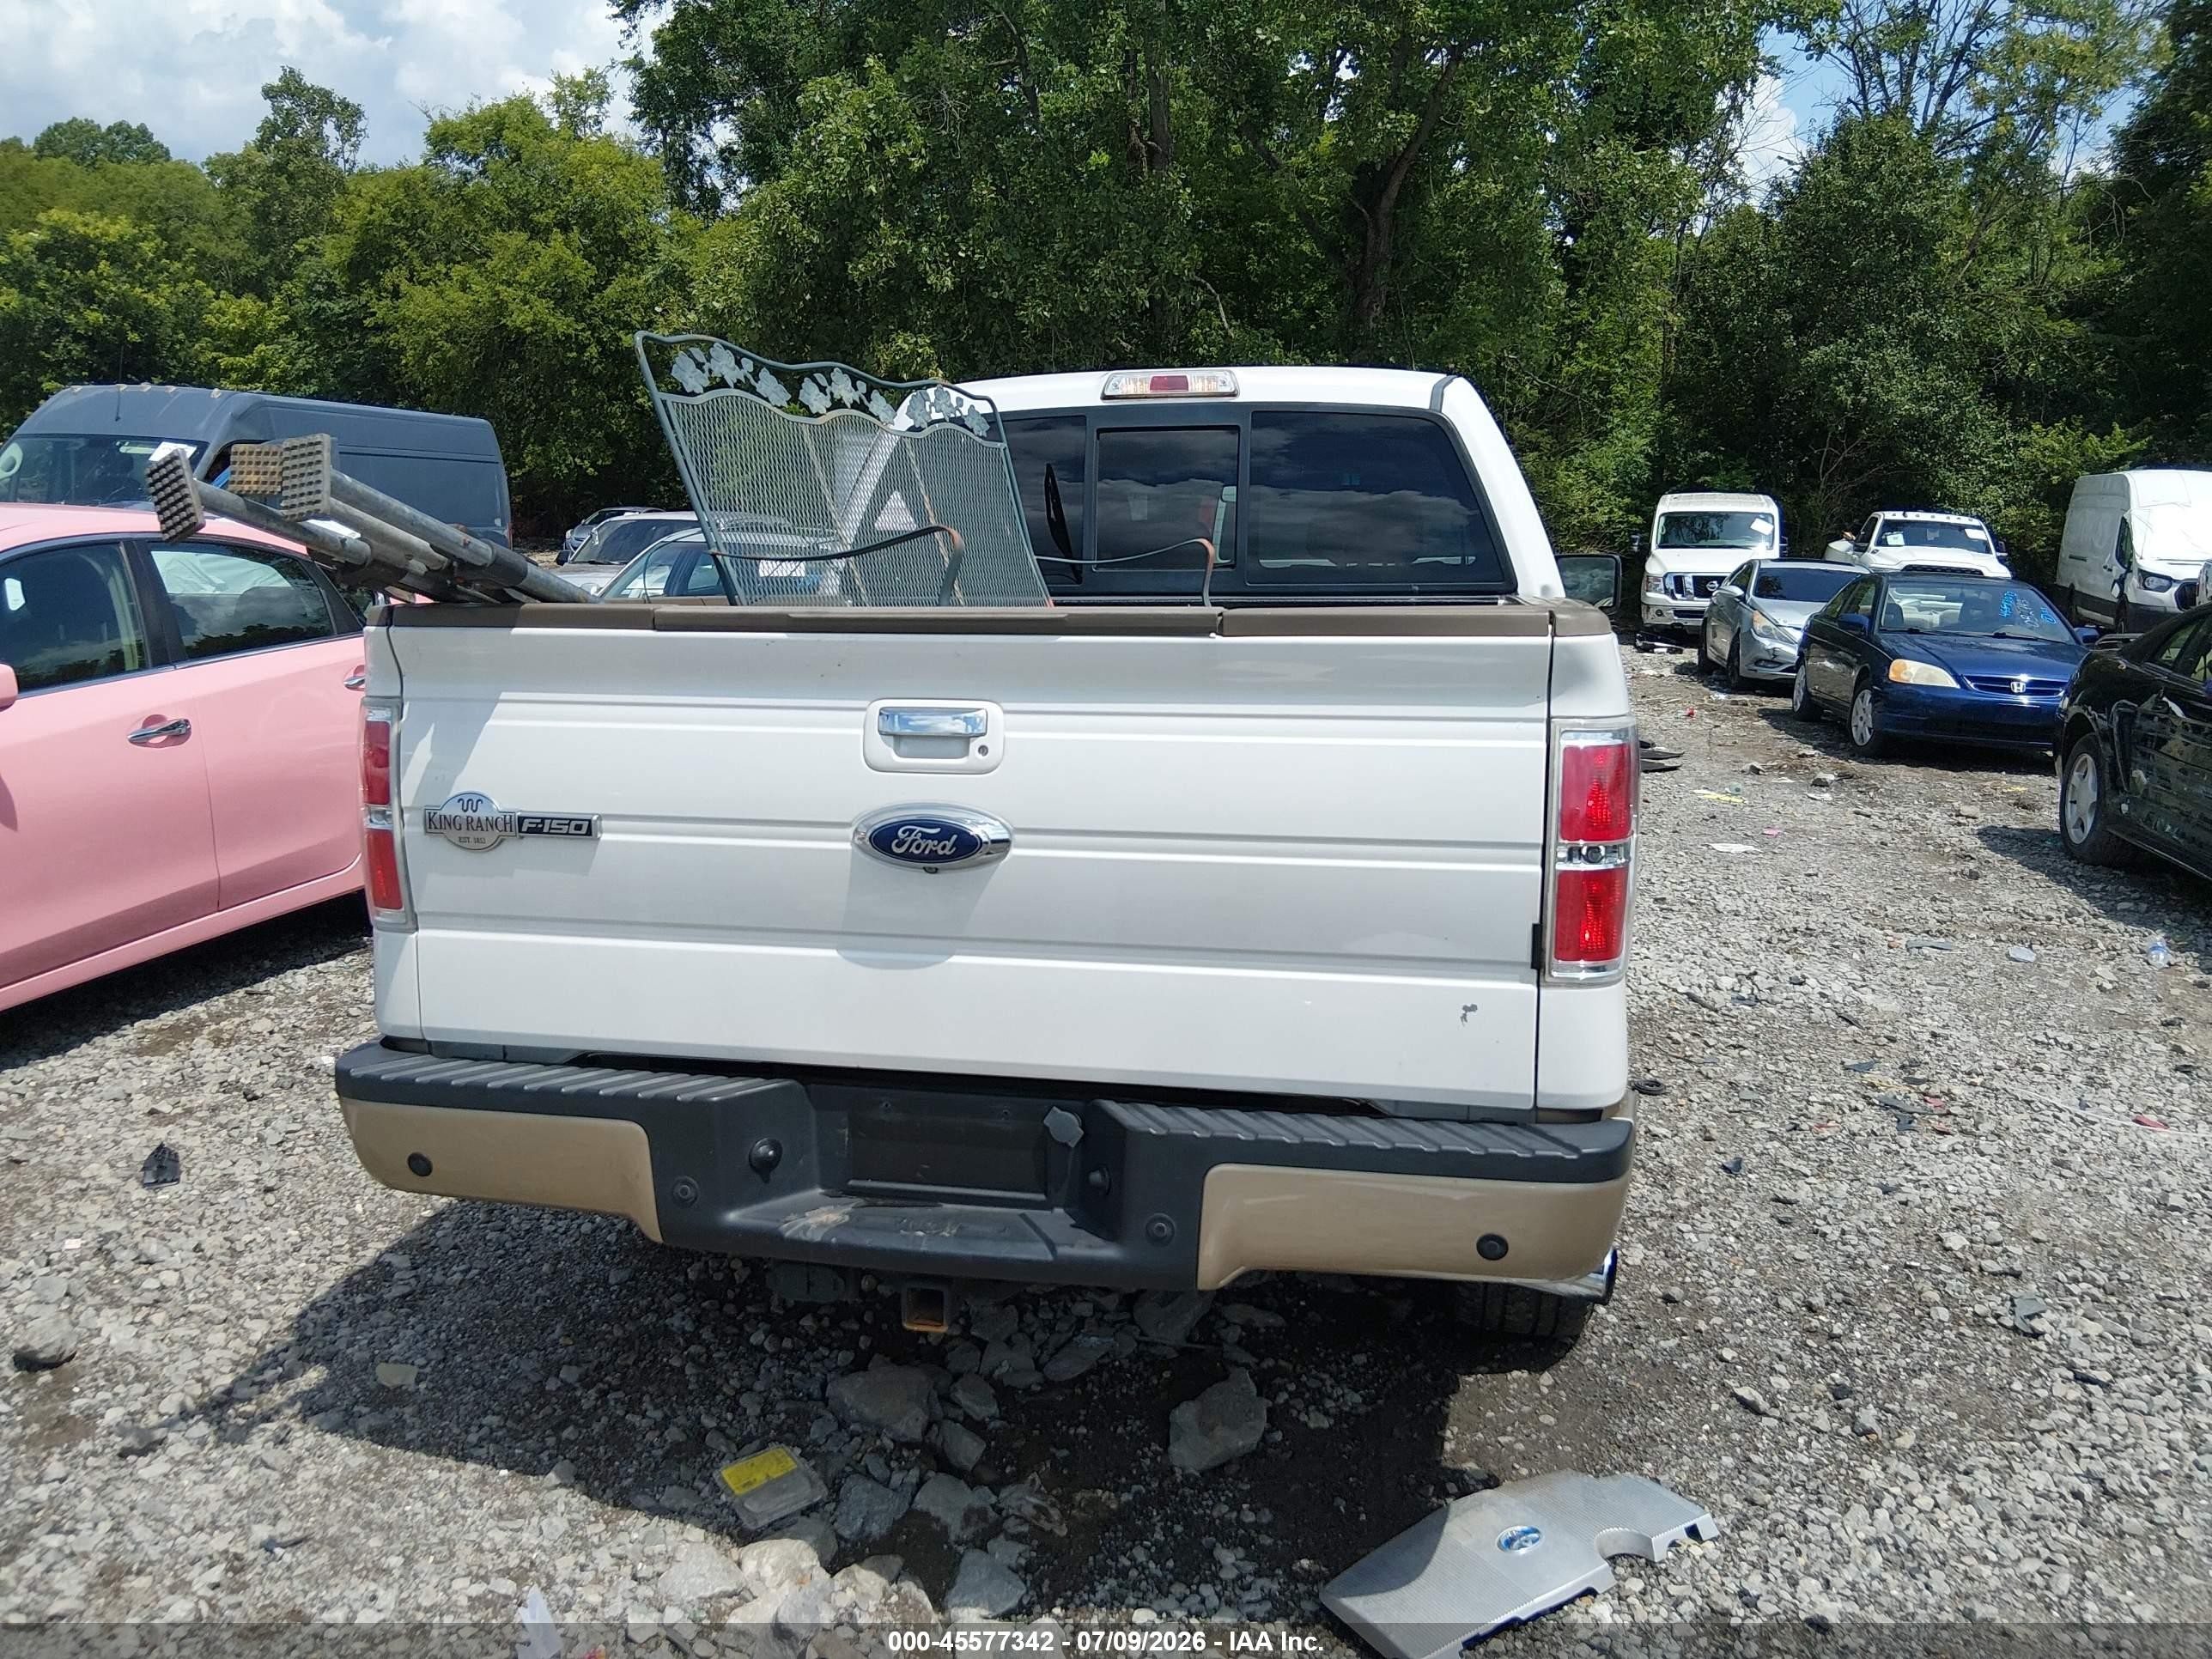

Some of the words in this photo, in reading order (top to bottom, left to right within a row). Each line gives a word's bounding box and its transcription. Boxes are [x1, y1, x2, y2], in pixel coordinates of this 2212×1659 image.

[428, 811, 462, 831] KING
[466, 814, 514, 833] RANCH
[521, 818, 590, 834] F-150
[891, 825, 957, 855] Ford
